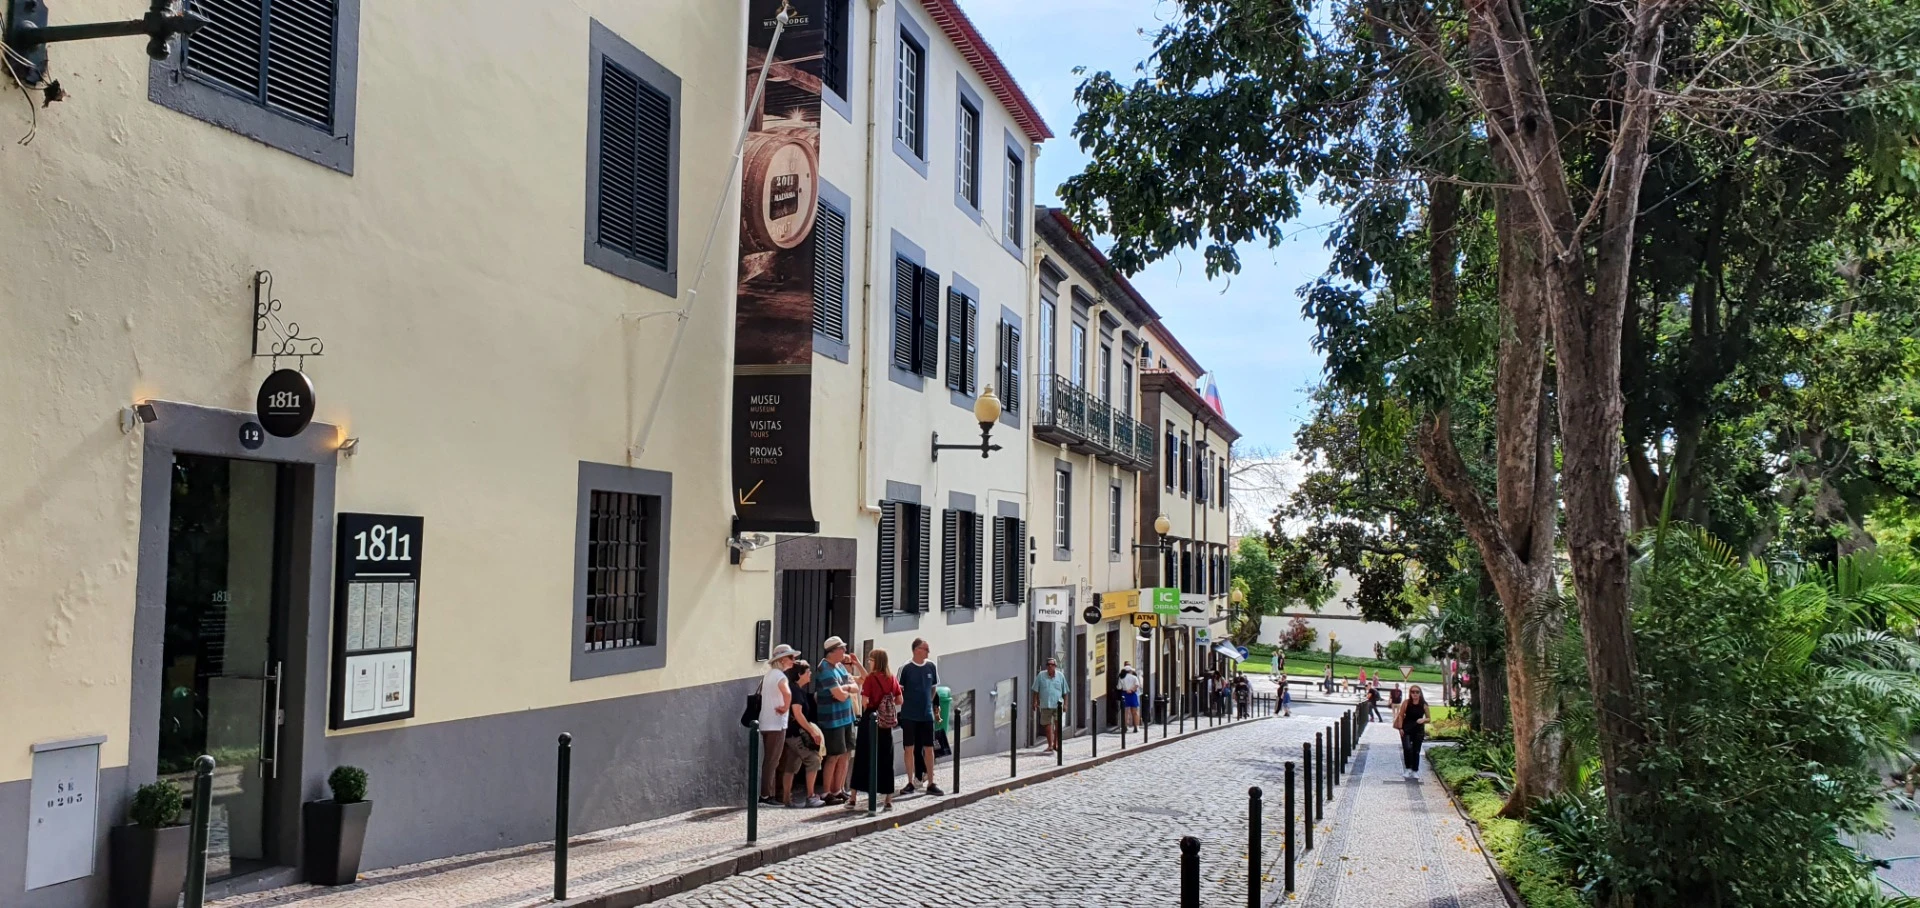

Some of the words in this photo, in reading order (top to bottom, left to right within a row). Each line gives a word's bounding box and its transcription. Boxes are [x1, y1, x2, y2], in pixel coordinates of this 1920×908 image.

[268, 391, 301, 408] 1811
[750, 394, 780, 405] MUSEU
[749, 420, 782, 430] VISITAS
[245, 430, 259, 441] 12
[749, 446, 783, 456] PROVAS
[749, 457, 777, 465] TASTINGS
[354, 524, 412, 561] 1811
[1160, 592, 1173, 602] IC
[1038, 607, 1063, 615] melior
